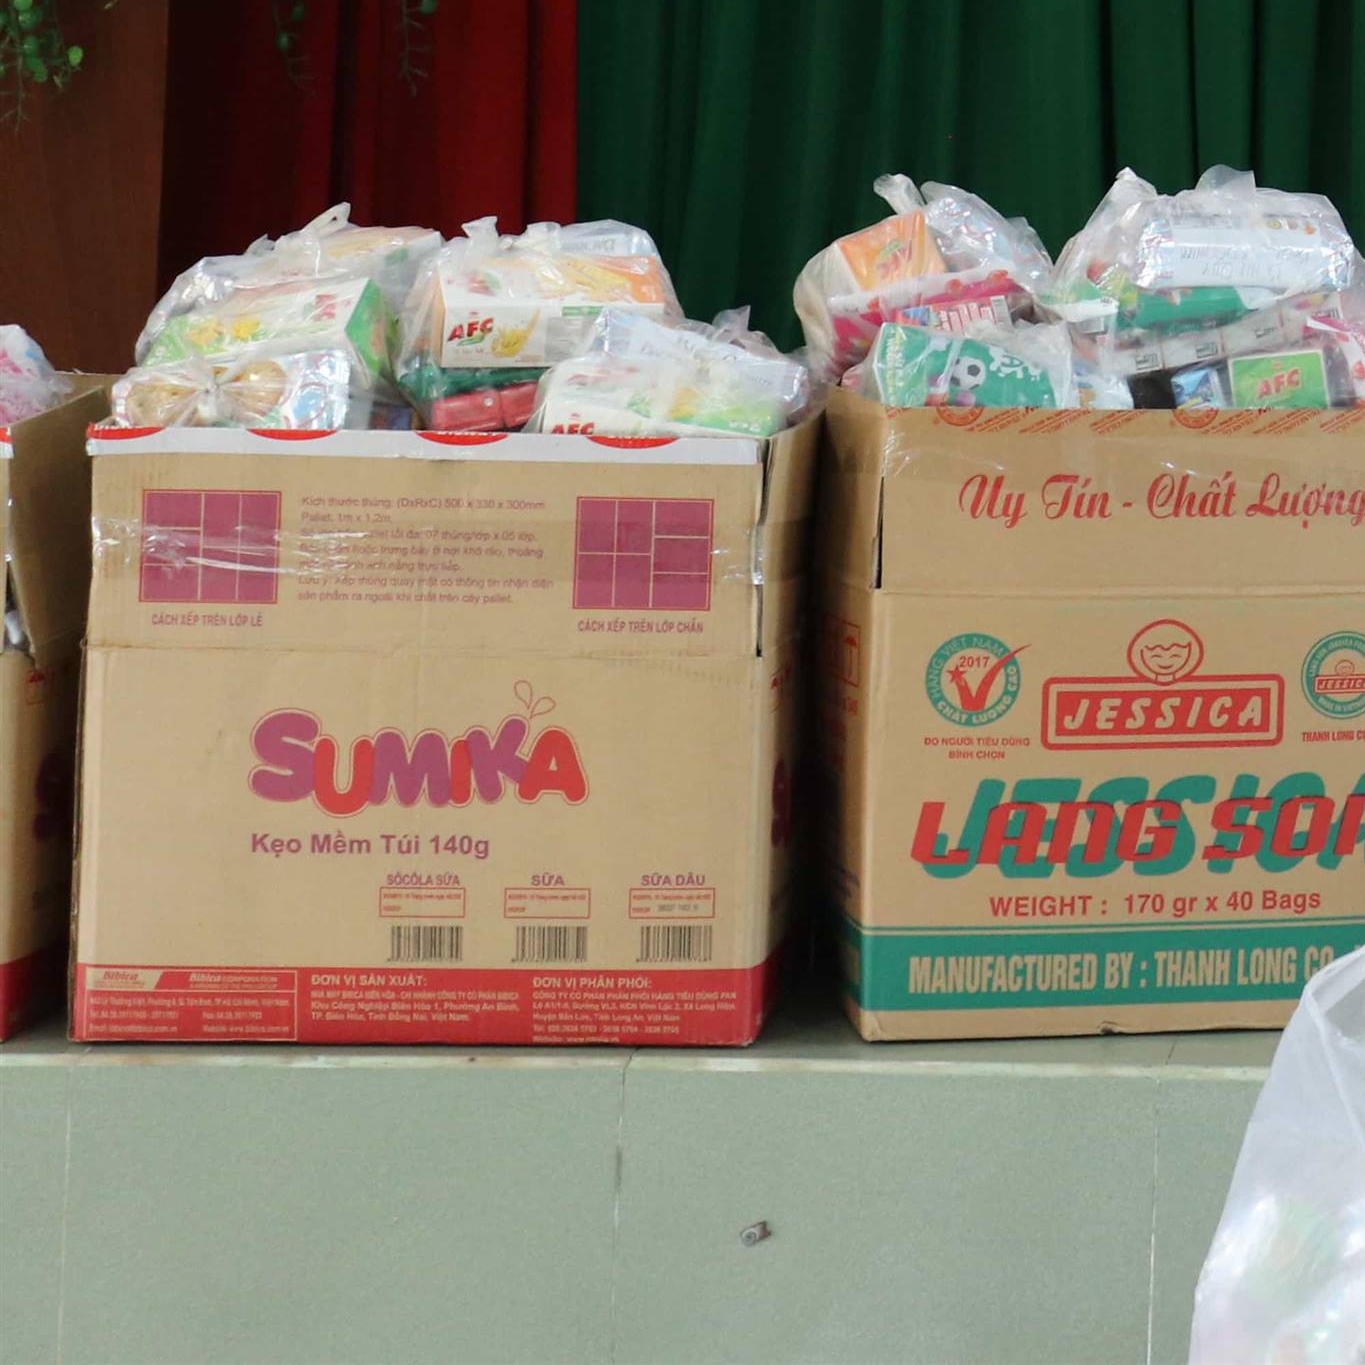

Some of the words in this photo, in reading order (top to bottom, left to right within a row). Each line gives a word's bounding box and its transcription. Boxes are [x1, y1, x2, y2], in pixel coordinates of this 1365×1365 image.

[447, 317, 495, 342] AFC
[1258, 368, 1300, 399] AFC
[959, 474, 1027, 528] Uy
[1041, 473, 1112, 519] Tín
[1147, 471, 1236, 519] Chất
[959, 656, 990, 668] 2017
[1064, 696, 1262, 729] JESSICA
[1302, 731, 1329, 743] THANH
[1332, 730, 1354, 742] LONG
[248, 707, 589, 818] SUMIKA
[251, 833, 301, 859] Kẹo
[311, 830, 371, 854] Mềm
[380, 834, 420, 854] Túi
[430, 835, 490, 860] 140g
[910, 800, 1181, 865] LANG
[990, 895, 1092, 917] WEIGHT
[1125, 894, 1164, 913] 170
[1172, 897, 1197, 918] gr
[1206, 897, 1218, 911] x
[1227, 891, 1253, 911] 40
[1262, 890, 1320, 914] Bags
[311, 974, 340, 985] ĐƠN
[343, 974, 356, 988] VỊ
[359, 973, 386, 986] SẢN
[533, 977, 561, 988] ĐƠN
[565, 977, 576, 990] VỊ
[579, 975, 614, 988] PHÂN
[909, 954, 1097, 994] MANUFACTURED
[1105, 954, 1134, 989] BY
[1155, 949, 1230, 987] THANH
[1237, 947, 1296, 984] LONG
